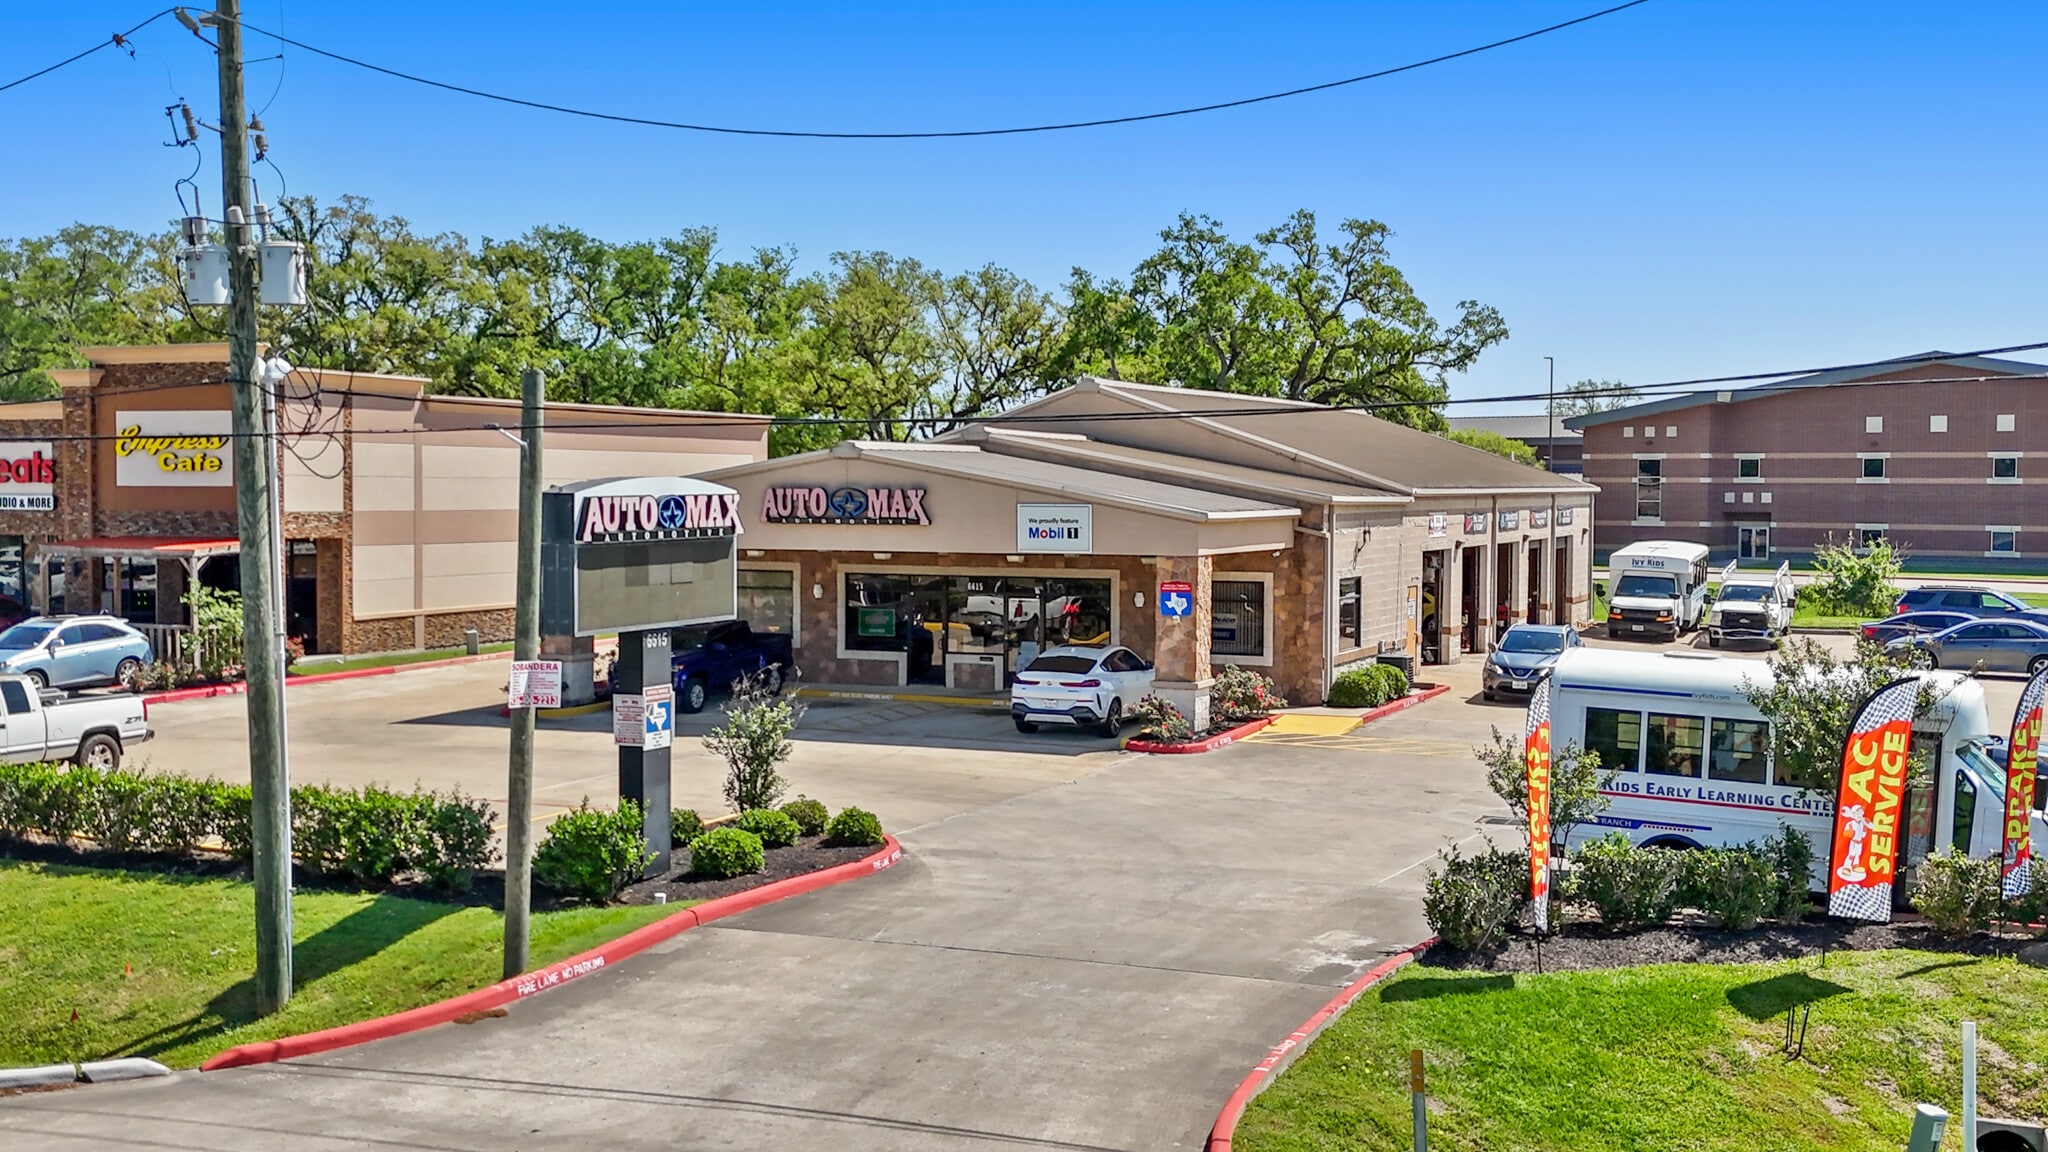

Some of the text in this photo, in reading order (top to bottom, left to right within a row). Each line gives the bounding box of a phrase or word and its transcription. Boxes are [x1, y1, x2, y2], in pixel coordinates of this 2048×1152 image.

[158, 451, 222, 472] Cafe
[27, 497, 51, 508] MORE
[760, 487, 931, 525] AUTO MAX
[583, 494, 744, 542] AUTO MAX
[605, 530, 725, 543] AUTOMOTIVE
[1029, 527, 1078, 539] Mobil 1
[967, 582, 984, 591] 6615
[646, 632, 668, 648] 6615
[1848, 739, 1878, 804] AC
[1646, 782, 1692, 799] EARLY
[1697, 787, 1774, 807] LEARNING
[1780, 795, 1835, 812] CENTE
[1869, 732, 1907, 875] SERVICE
[1601, 818, 1632, 827] RANCH
[518, 980, 537, 996] FIRE
[562, 966, 574, 980] NO
[574, 956, 605, 976] PARKING
